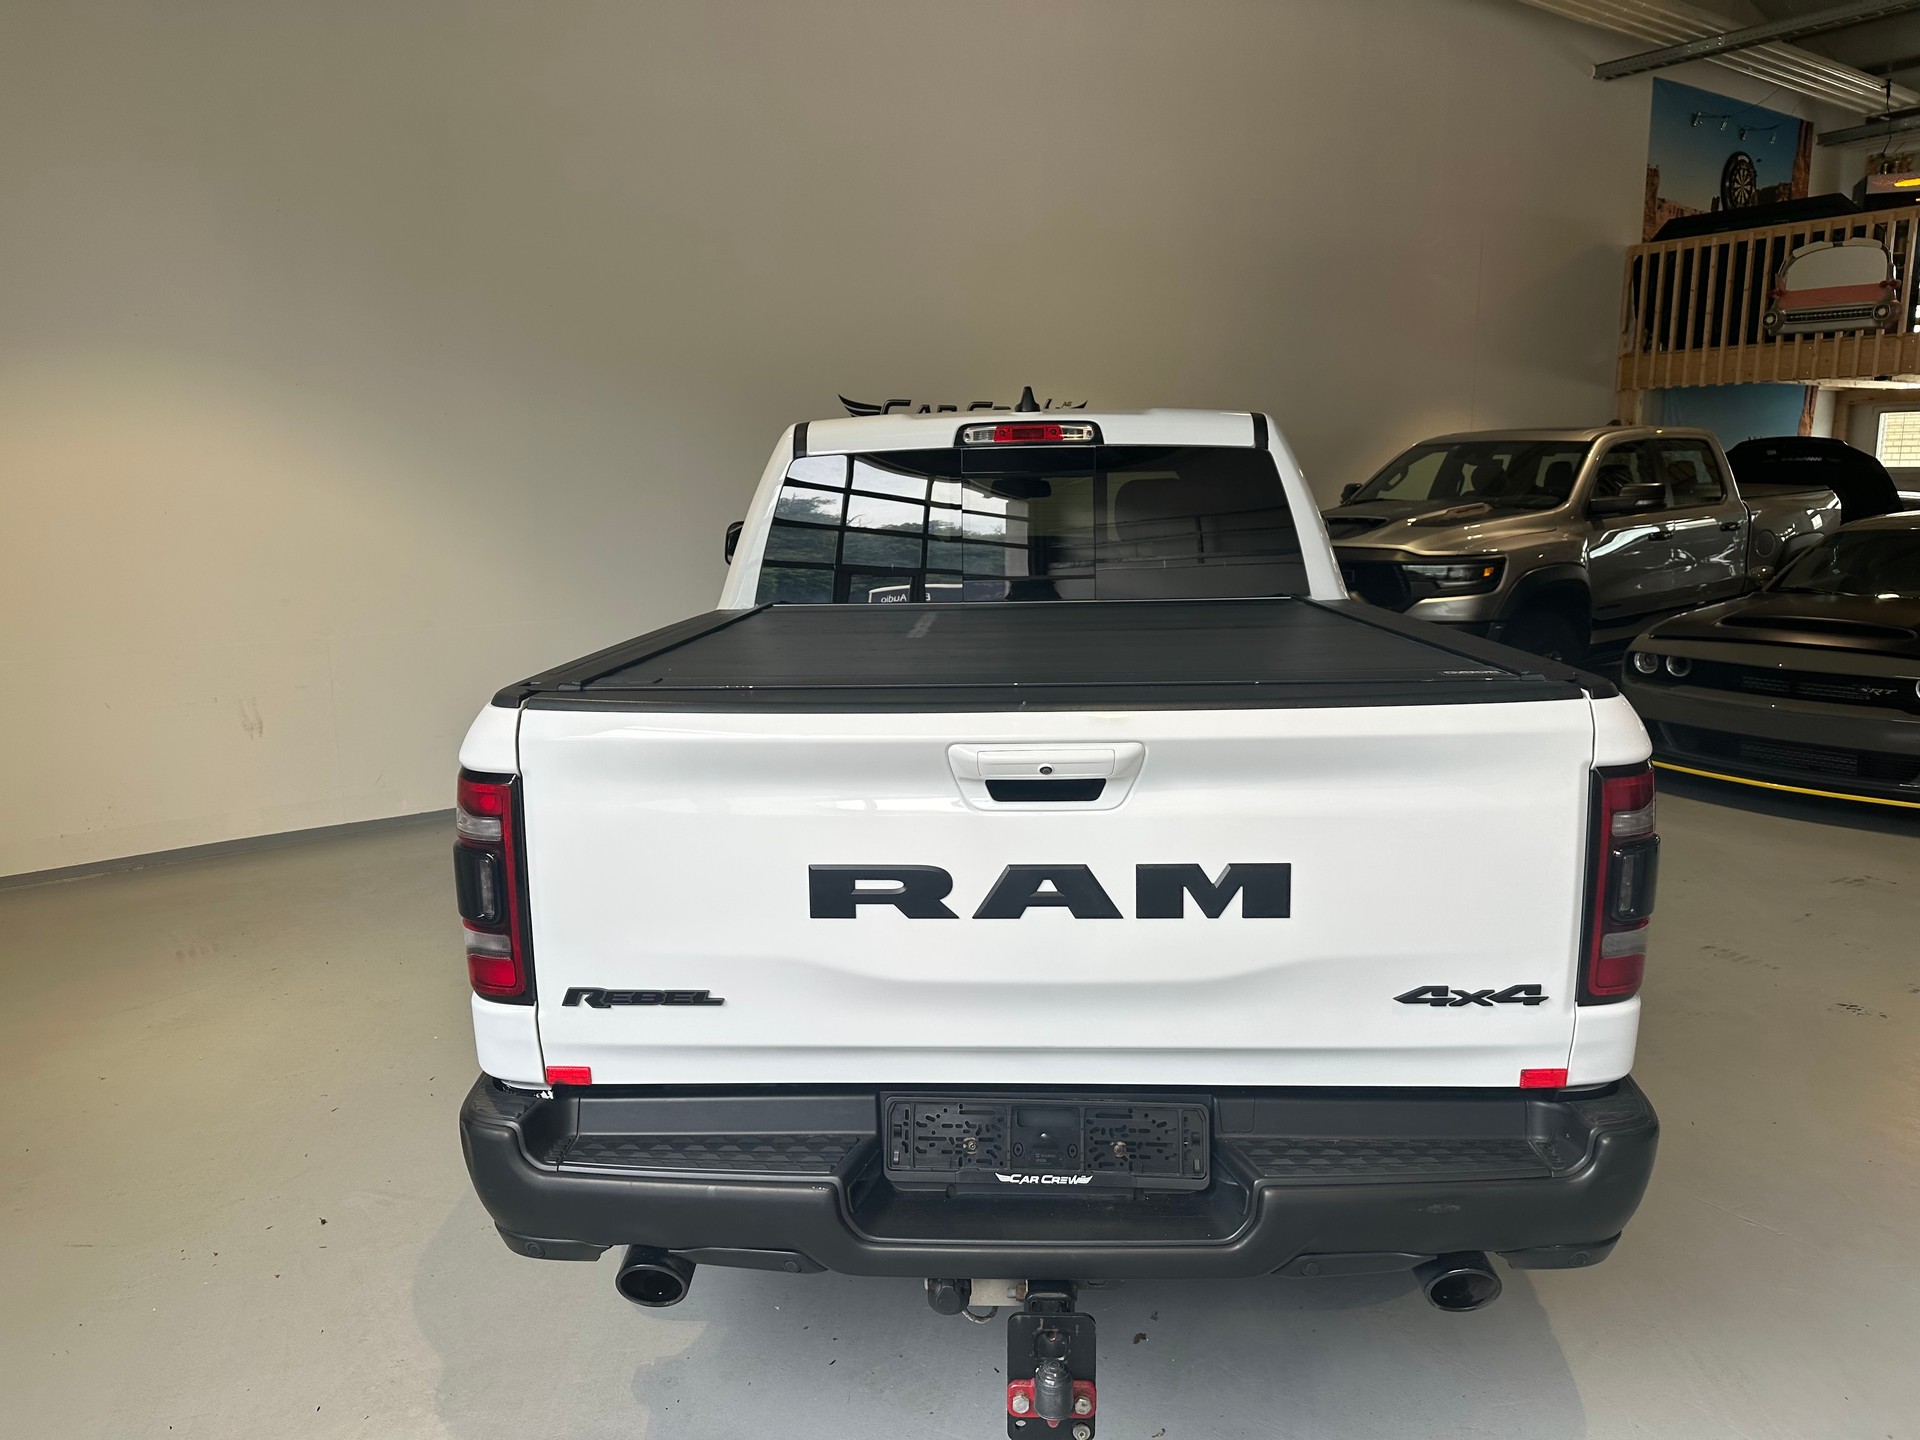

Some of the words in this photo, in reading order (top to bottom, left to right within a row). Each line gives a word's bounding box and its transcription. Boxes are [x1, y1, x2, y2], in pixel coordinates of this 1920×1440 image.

[808, 863, 1291, 919] RAM
[561, 987, 725, 1009] REBEL
[1392, 984, 1549, 1007] 4x4
[1009, 1174, 1040, 1185] CAR
[1040, 1174, 1081, 1185] CREW
